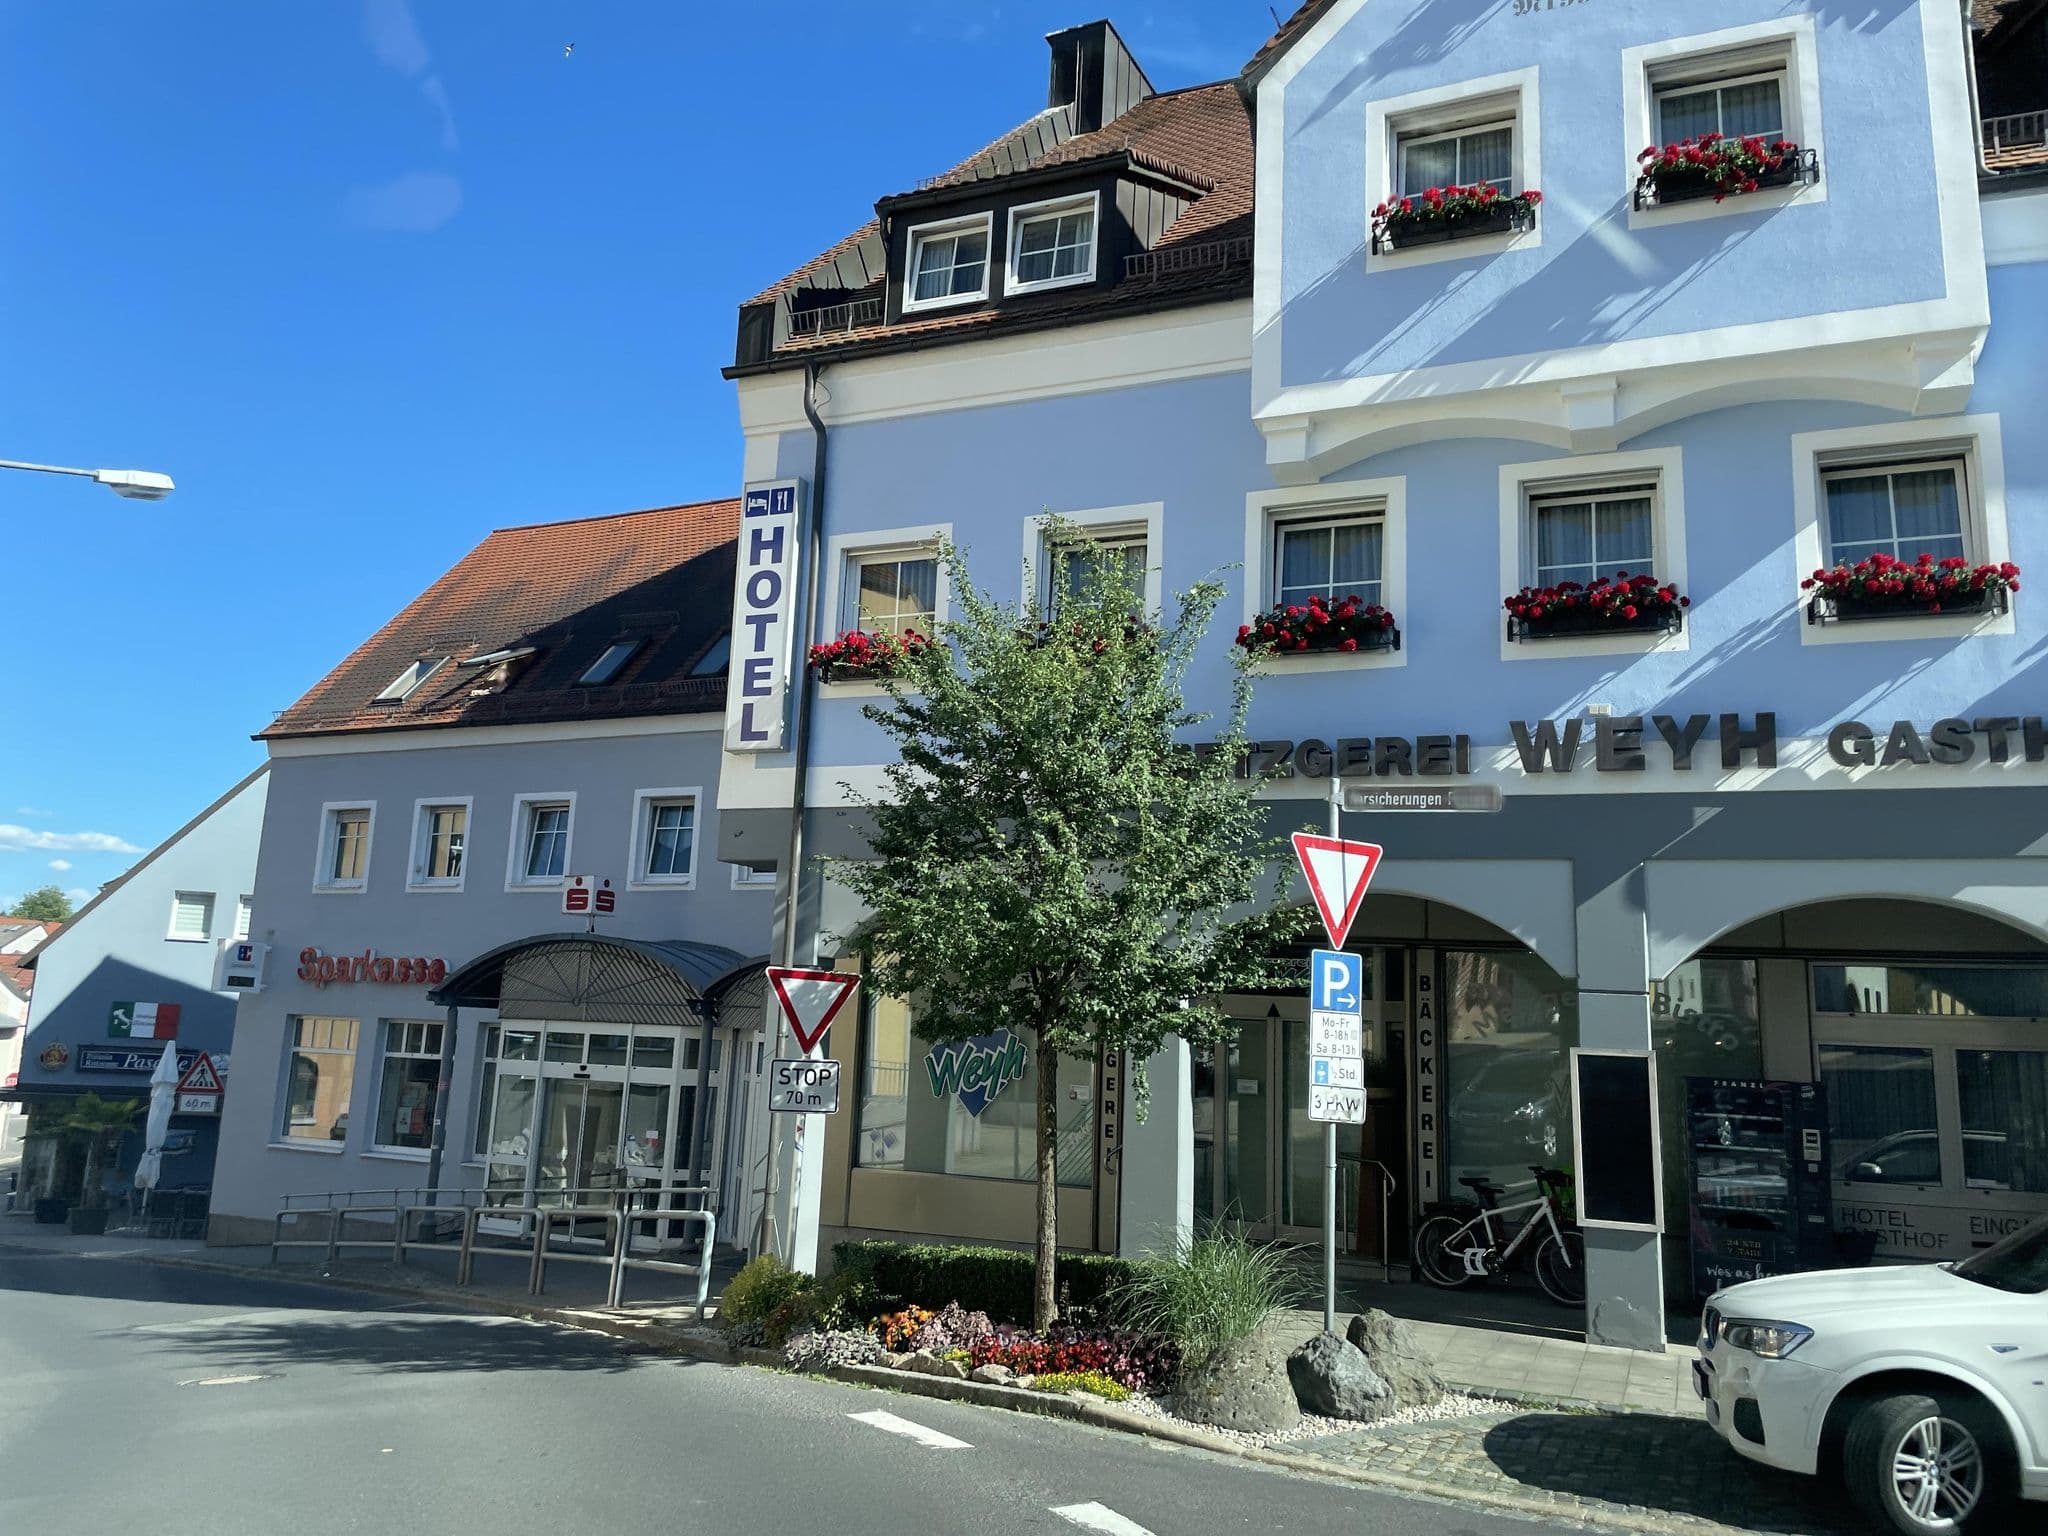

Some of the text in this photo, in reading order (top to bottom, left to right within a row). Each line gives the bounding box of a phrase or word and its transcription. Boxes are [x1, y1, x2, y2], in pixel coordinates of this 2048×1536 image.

[740, 526, 784, 742] HOTEL
[1165, 734, 1470, 780] TZGEREI
[1509, 712, 1777, 773] WEYH
[1358, 790, 1442, 809] rsicherungen
[297, 947, 450, 988] Sparkasse
[1322, 959, 1350, 1008] P
[1322, 1017, 1351, 1029] Mo-Fr
[1324, 1030, 1349, 1042] 8-18h
[1316, 1043, 1357, 1056] Sa 8-13h
[778, 1067, 832, 1086] STOP
[924, 1033, 1028, 1101] Weyh
[1418, 975, 1434, 1188] BÄCKEREI
[786, 1090, 822, 1105] 70 m
[1314, 1094, 1322, 1109] 3
[1841, 1207, 1915, 1228] HOTEL
[1840, 1226, 1950, 1249] STHOF
